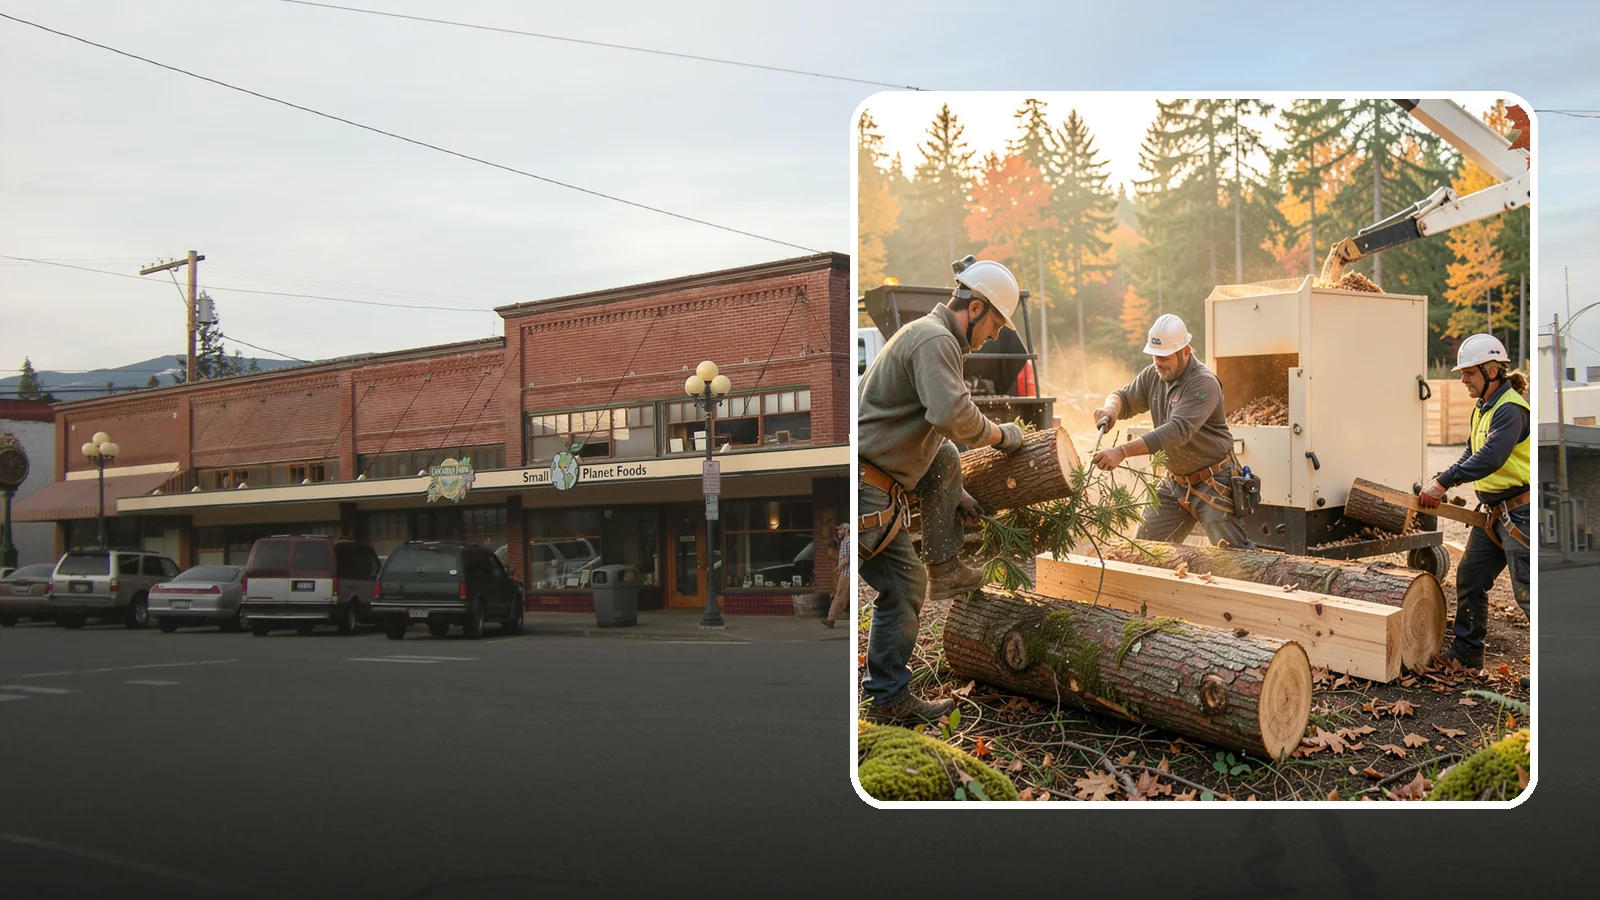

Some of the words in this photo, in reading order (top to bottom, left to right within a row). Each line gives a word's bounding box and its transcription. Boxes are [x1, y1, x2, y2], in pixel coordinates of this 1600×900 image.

[523, 471, 549, 483] Small
[582, 466, 614, 479] Planet
[616, 464, 647, 477] Foods
